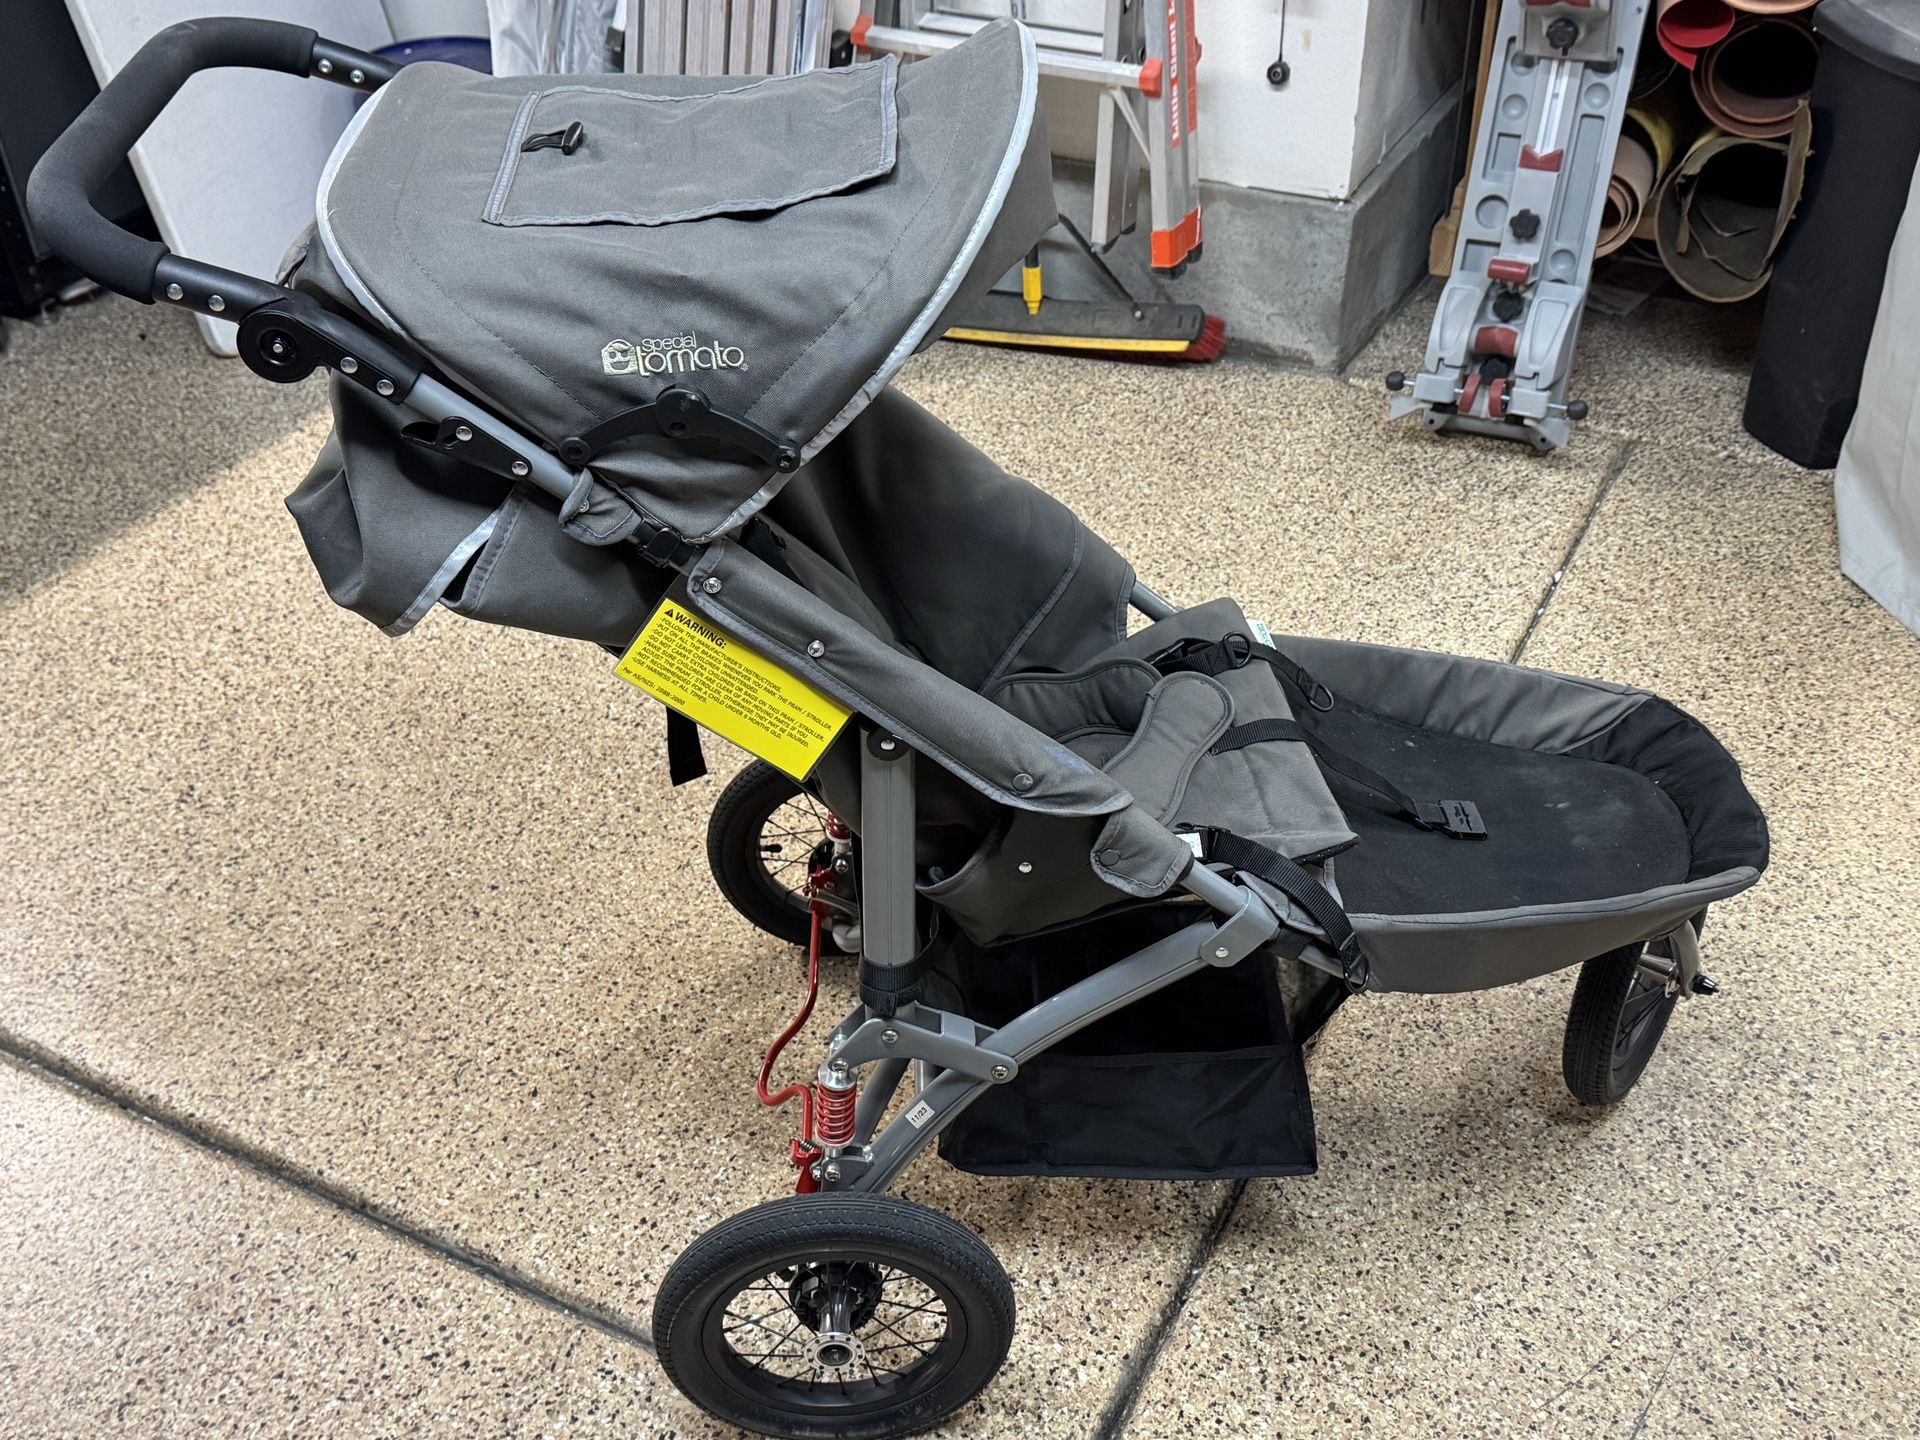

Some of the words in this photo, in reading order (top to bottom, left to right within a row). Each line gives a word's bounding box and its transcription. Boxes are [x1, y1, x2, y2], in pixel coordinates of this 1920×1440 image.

[636, 340, 745, 377] tomato
[642, 331, 697, 353] special
[673, 611, 728, 649] WARNING:
[662, 634, 676, 644] NOT
[674, 641, 693, 655] LEAVE
[691, 651, 720, 671] CHILDREN
[668, 629, 679, 638] ON
[677, 635, 690, 645] ALL
[688, 641, 701, 651] THE
[699, 648, 723, 665] BRAKES
[721, 661, 752, 682] WHENEVER
[750, 679, 763, 689] YOU
[762, 686, 777, 697] PARK
[776, 694, 788, 704] THE
[786, 700, 803, 713] PRAM
[683, 631, 697, 641] THE
[695, 638, 743, 669] MANUFACTURER'S
[741, 666, 782, 693] INSTRUCTIONS.
[621, 666, 634, 675] Per
[631, 671, 656, 689] AS/NZS:
[654, 685, 686, 706] 2088:2000
[641, 645, 663, 661] ADJUST
[662, 658, 676, 668] THE
[674, 665, 691, 677] PRAM
[722, 693, 754, 715] OTHERWISE
[753, 711, 768, 723] THEY
[766, 719, 779, 730] MAY
[777, 726, 787, 734] BE
[644, 663, 671, 681] HARNESS
[670, 678, 679, 686] AT
[677, 683, 690, 693] ALL
[688, 689, 709, 703] TIMES.
[648, 658, 692, 686] RECOMMENDED
[690, 682, 703, 692] FOR
[706, 692, 725, 705] CHILD
[723, 702, 744, 716] UNDER
[747, 716, 771, 732] MONTHS
[769, 729, 783, 739] OLD.
[658, 639, 672, 650] NOT
[670, 646, 690, 661] CARRY
[688, 658, 708, 672] EXTRA
[706, 668, 735, 688] CHILDREN
[733, 684, 744, 693] OR
[742, 690, 759, 702] BAGS
[757, 698, 767, 707] ON
[765, 703, 780, 714] THIS
[778, 711, 795, 723] PRAM
[660, 649, 677, 661] SURE
[675, 658, 705, 677] CHILDREN
[703, 674, 716, 684] ARE
[714, 681, 733, 695] CLEAR
[732, 691, 741, 699] OF
[740, 696, 753, 706] ANY
[751, 702, 774, 719] MOVING
[772, 715, 791, 728] PARTS
[795, 728, 808, 739] YOU
[911, 1106, 928, 1123] 11/23
